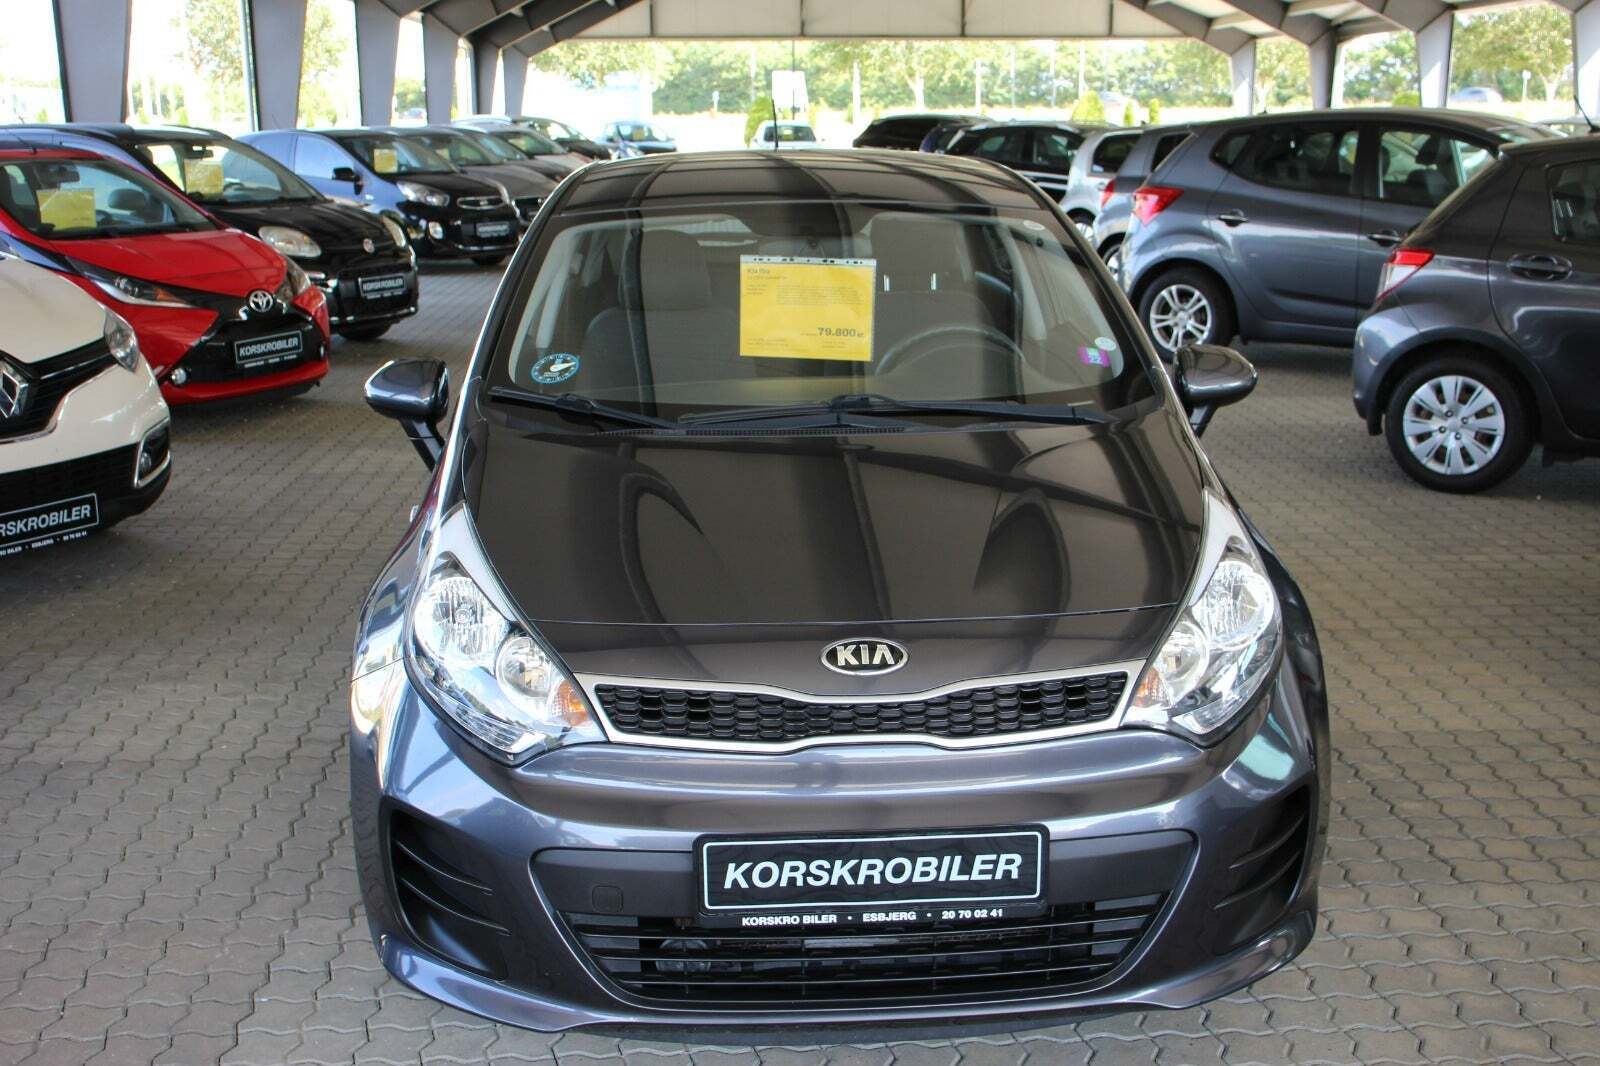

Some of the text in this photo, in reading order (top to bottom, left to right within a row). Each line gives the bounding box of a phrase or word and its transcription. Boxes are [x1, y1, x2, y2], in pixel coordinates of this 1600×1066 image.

[817, 327, 856, 337] 79.800
[239, 337, 299, 357] KORSKROBILER
[836, 644, 895, 666] KIA
[724, 853, 1022, 889] KORSKROBILER
[742, 908, 1004, 926] KORSKRO BILER ESBJERG 20 70 02 41
